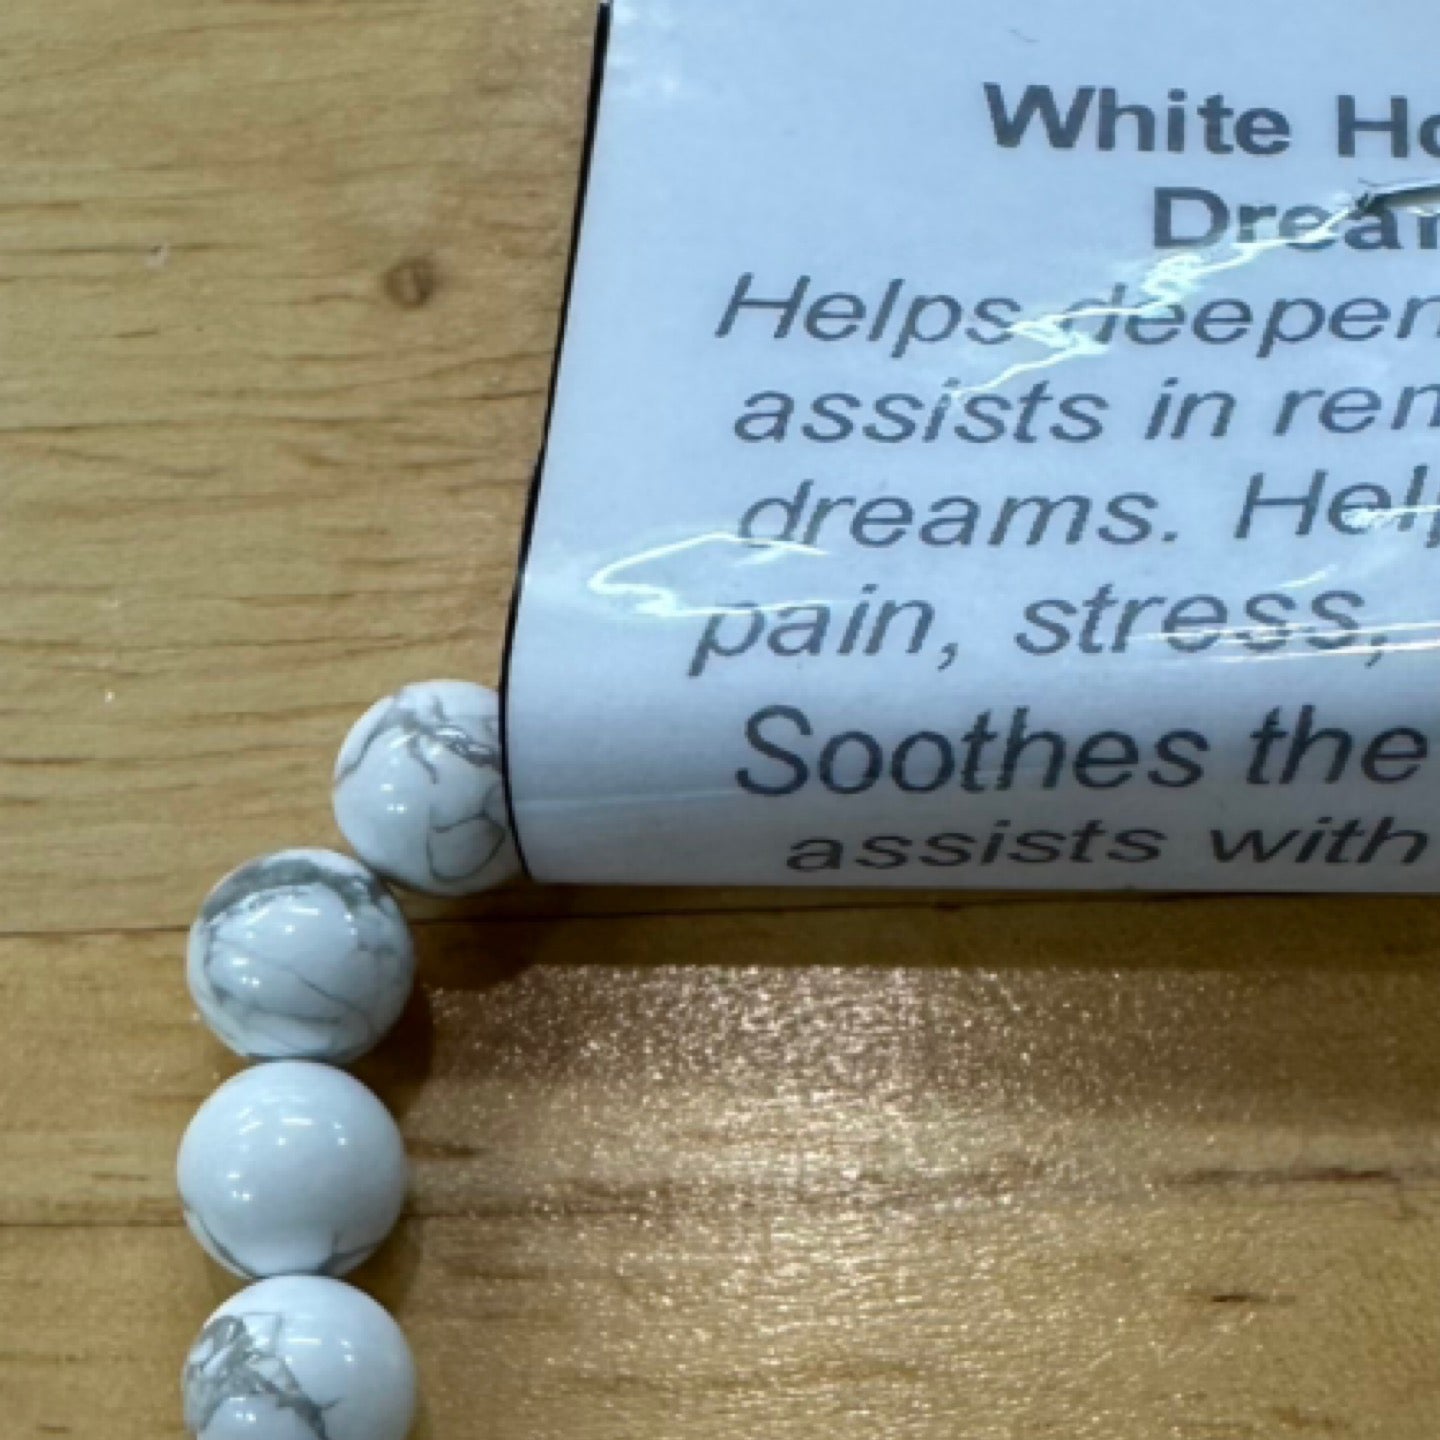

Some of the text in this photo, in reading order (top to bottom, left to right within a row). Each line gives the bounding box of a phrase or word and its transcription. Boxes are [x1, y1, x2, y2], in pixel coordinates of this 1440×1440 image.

[983, 82, 1292, 156] White
[714, 272, 1024, 359] Helps
[732, 379, 1110, 444] assists
[1144, 377, 1238, 440] in
[735, 479, 1180, 548] dreams.
[686, 583, 960, 678] pain,
[1014, 584, 1390, 669] stress,
[735, 704, 1212, 796] Soothes
[1246, 705, 1430, 788] the
[784, 819, 1168, 872] assists
[1208, 815, 1430, 866] with
